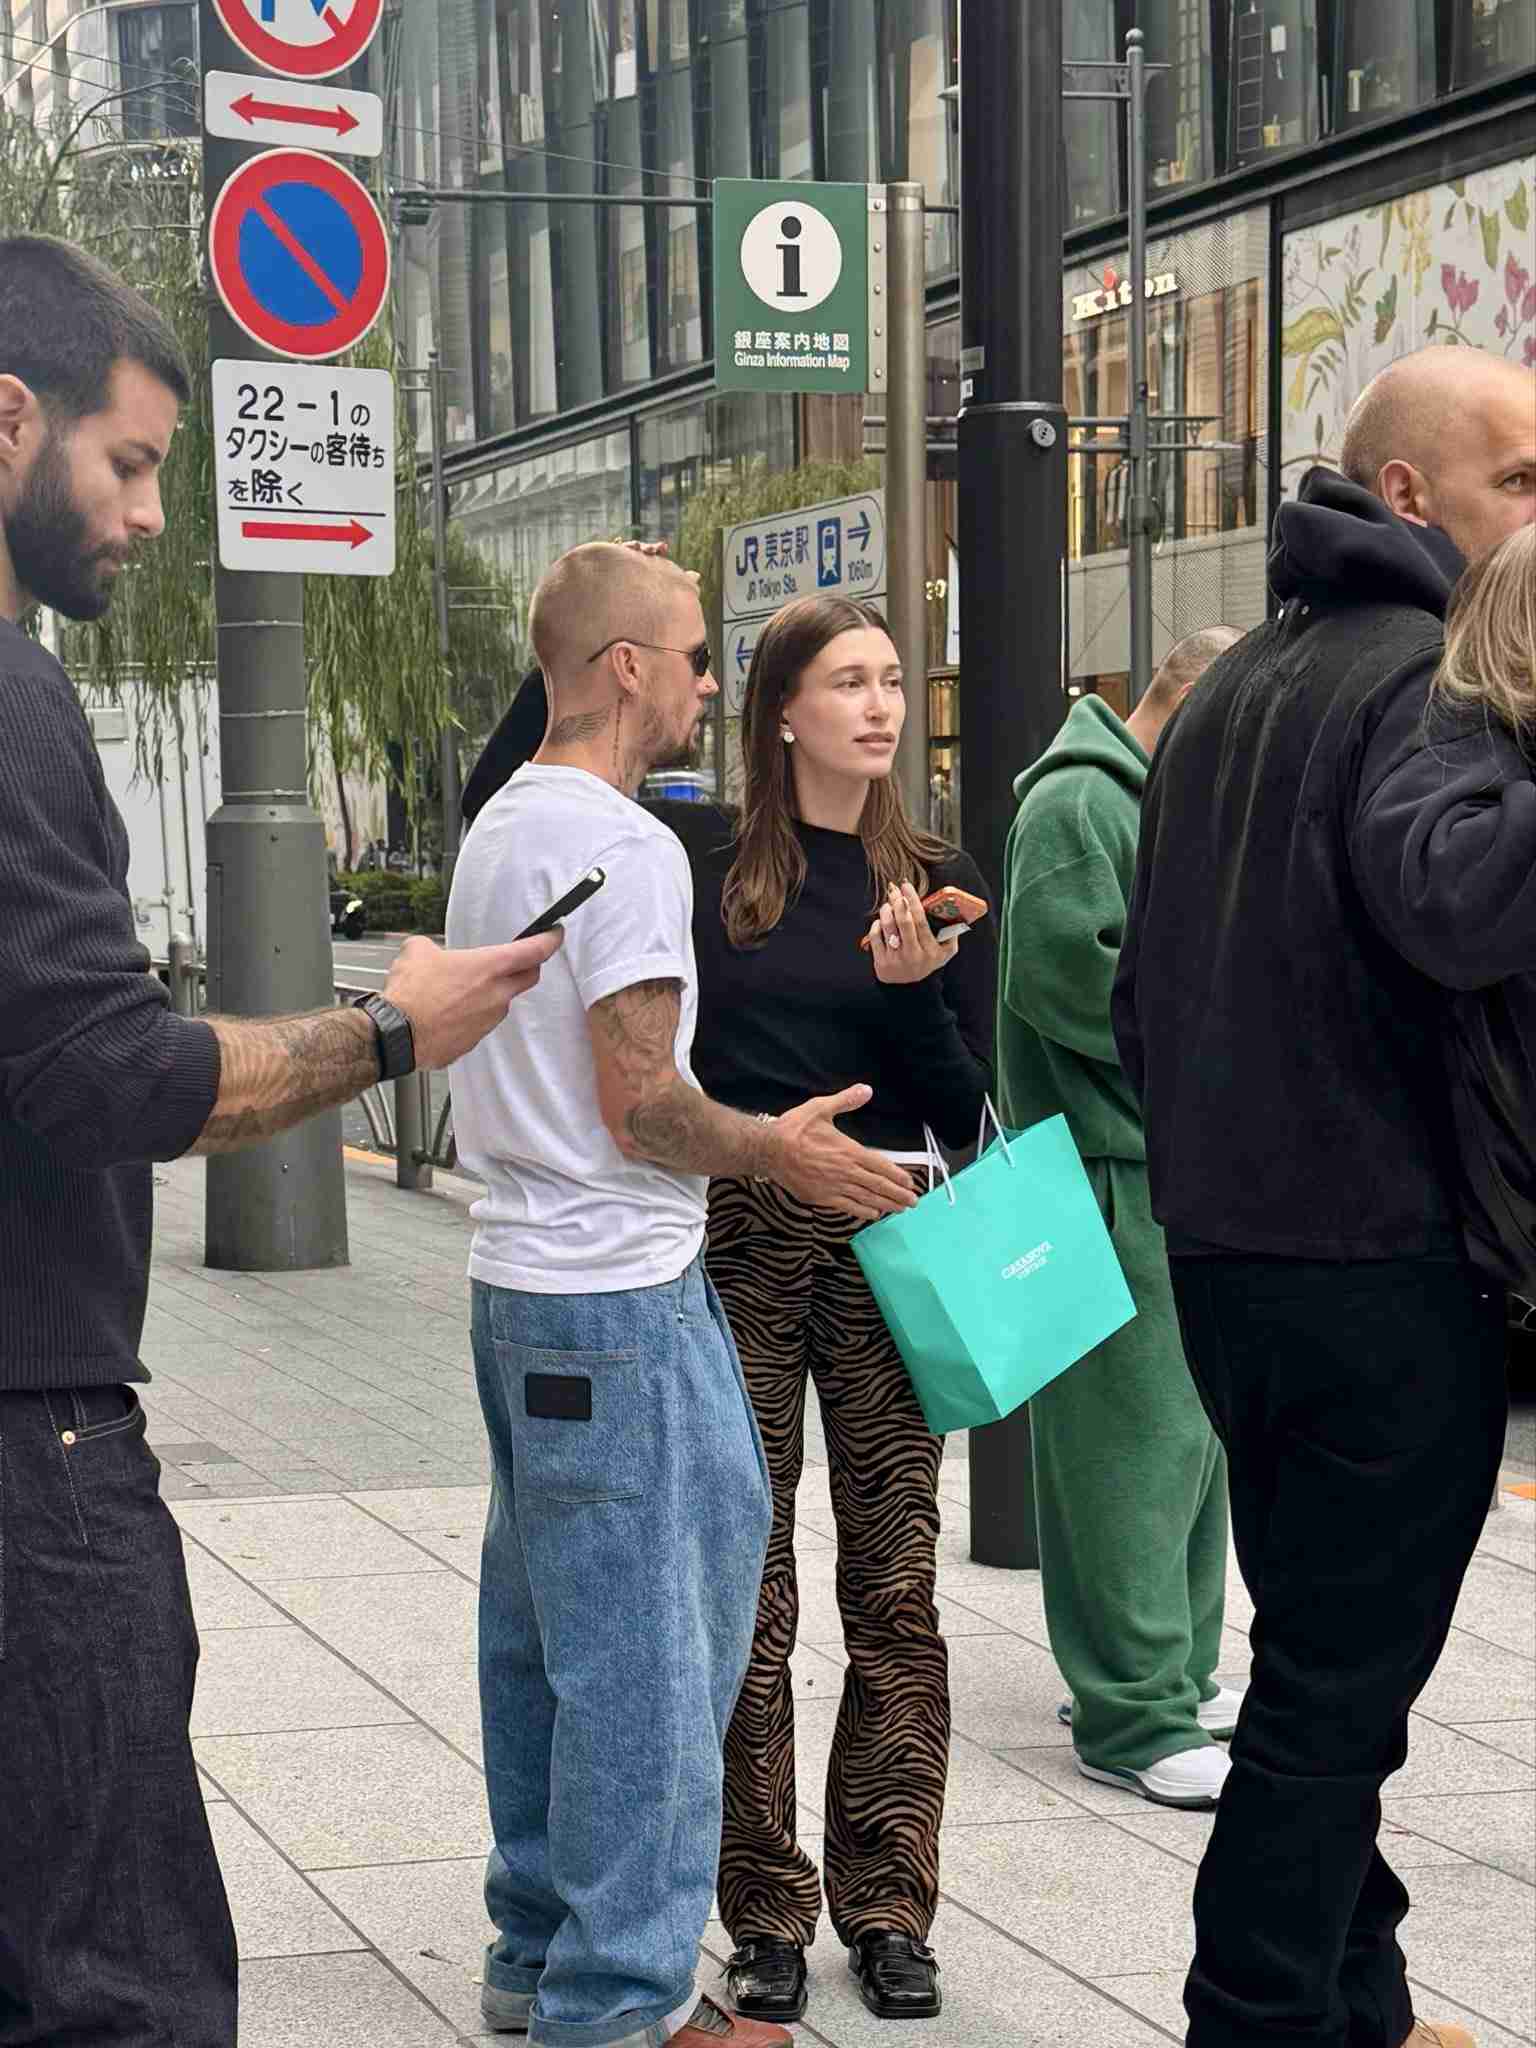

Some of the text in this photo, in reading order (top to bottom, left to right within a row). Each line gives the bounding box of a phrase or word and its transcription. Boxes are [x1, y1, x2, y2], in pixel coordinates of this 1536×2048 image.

[734, 330, 849, 352] 銀座案内地図
[734, 351, 850, 373] Ginza Information Map
[226, 426, 386, 469] タクシーの客待ち
[228, 468, 304, 506] を除く
[759, 577, 782, 602] Tokyo
